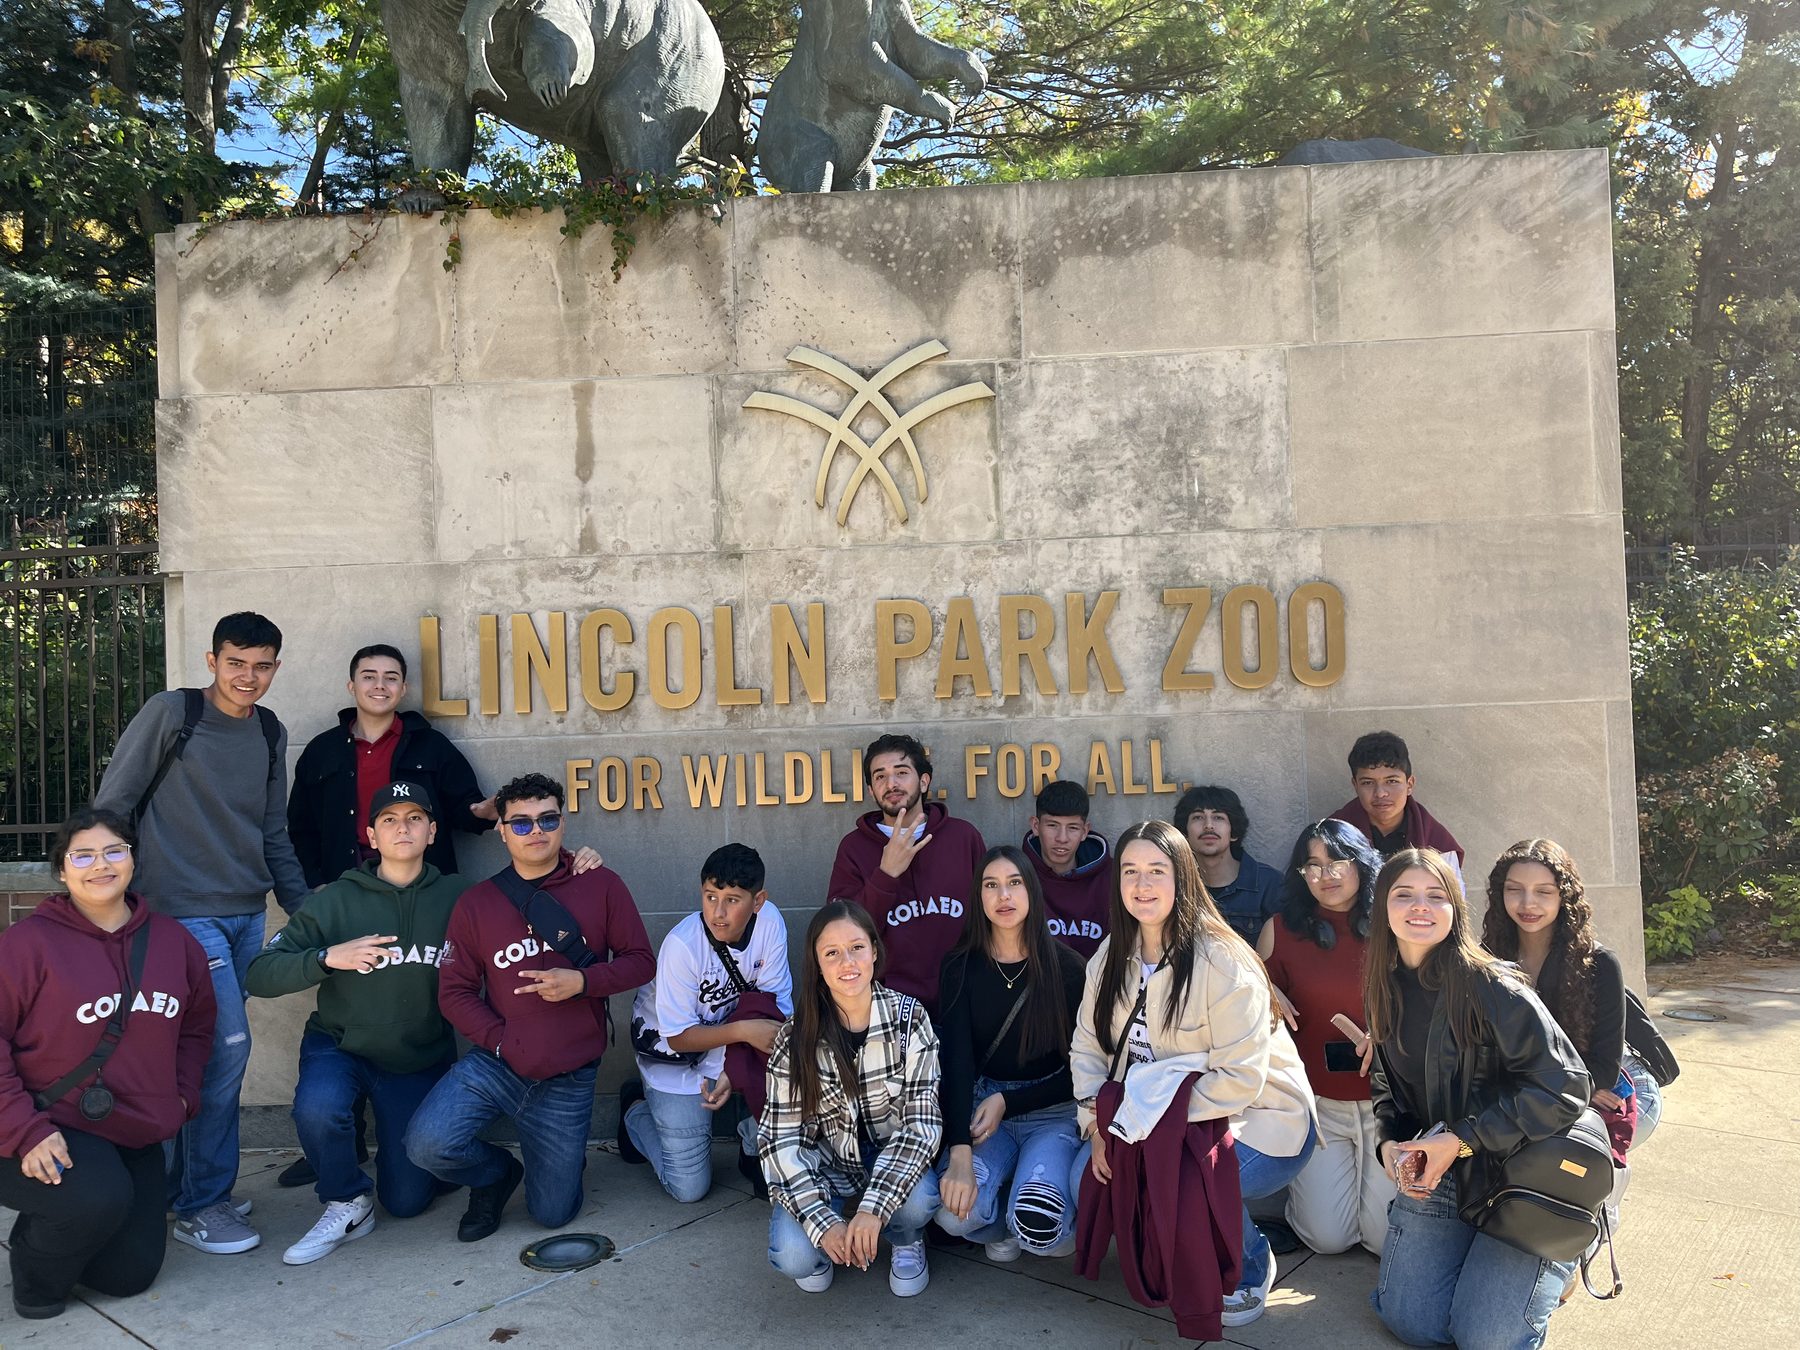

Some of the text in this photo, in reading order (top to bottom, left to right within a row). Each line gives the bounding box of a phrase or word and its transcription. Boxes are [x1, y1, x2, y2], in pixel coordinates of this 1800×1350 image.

[420, 582, 1346, 716] LINCOLN PARK ZOO
[566, 755, 663, 812] FOR
[965, 743, 1061, 799] FOR
[1087, 739, 1193, 796] ALL.
